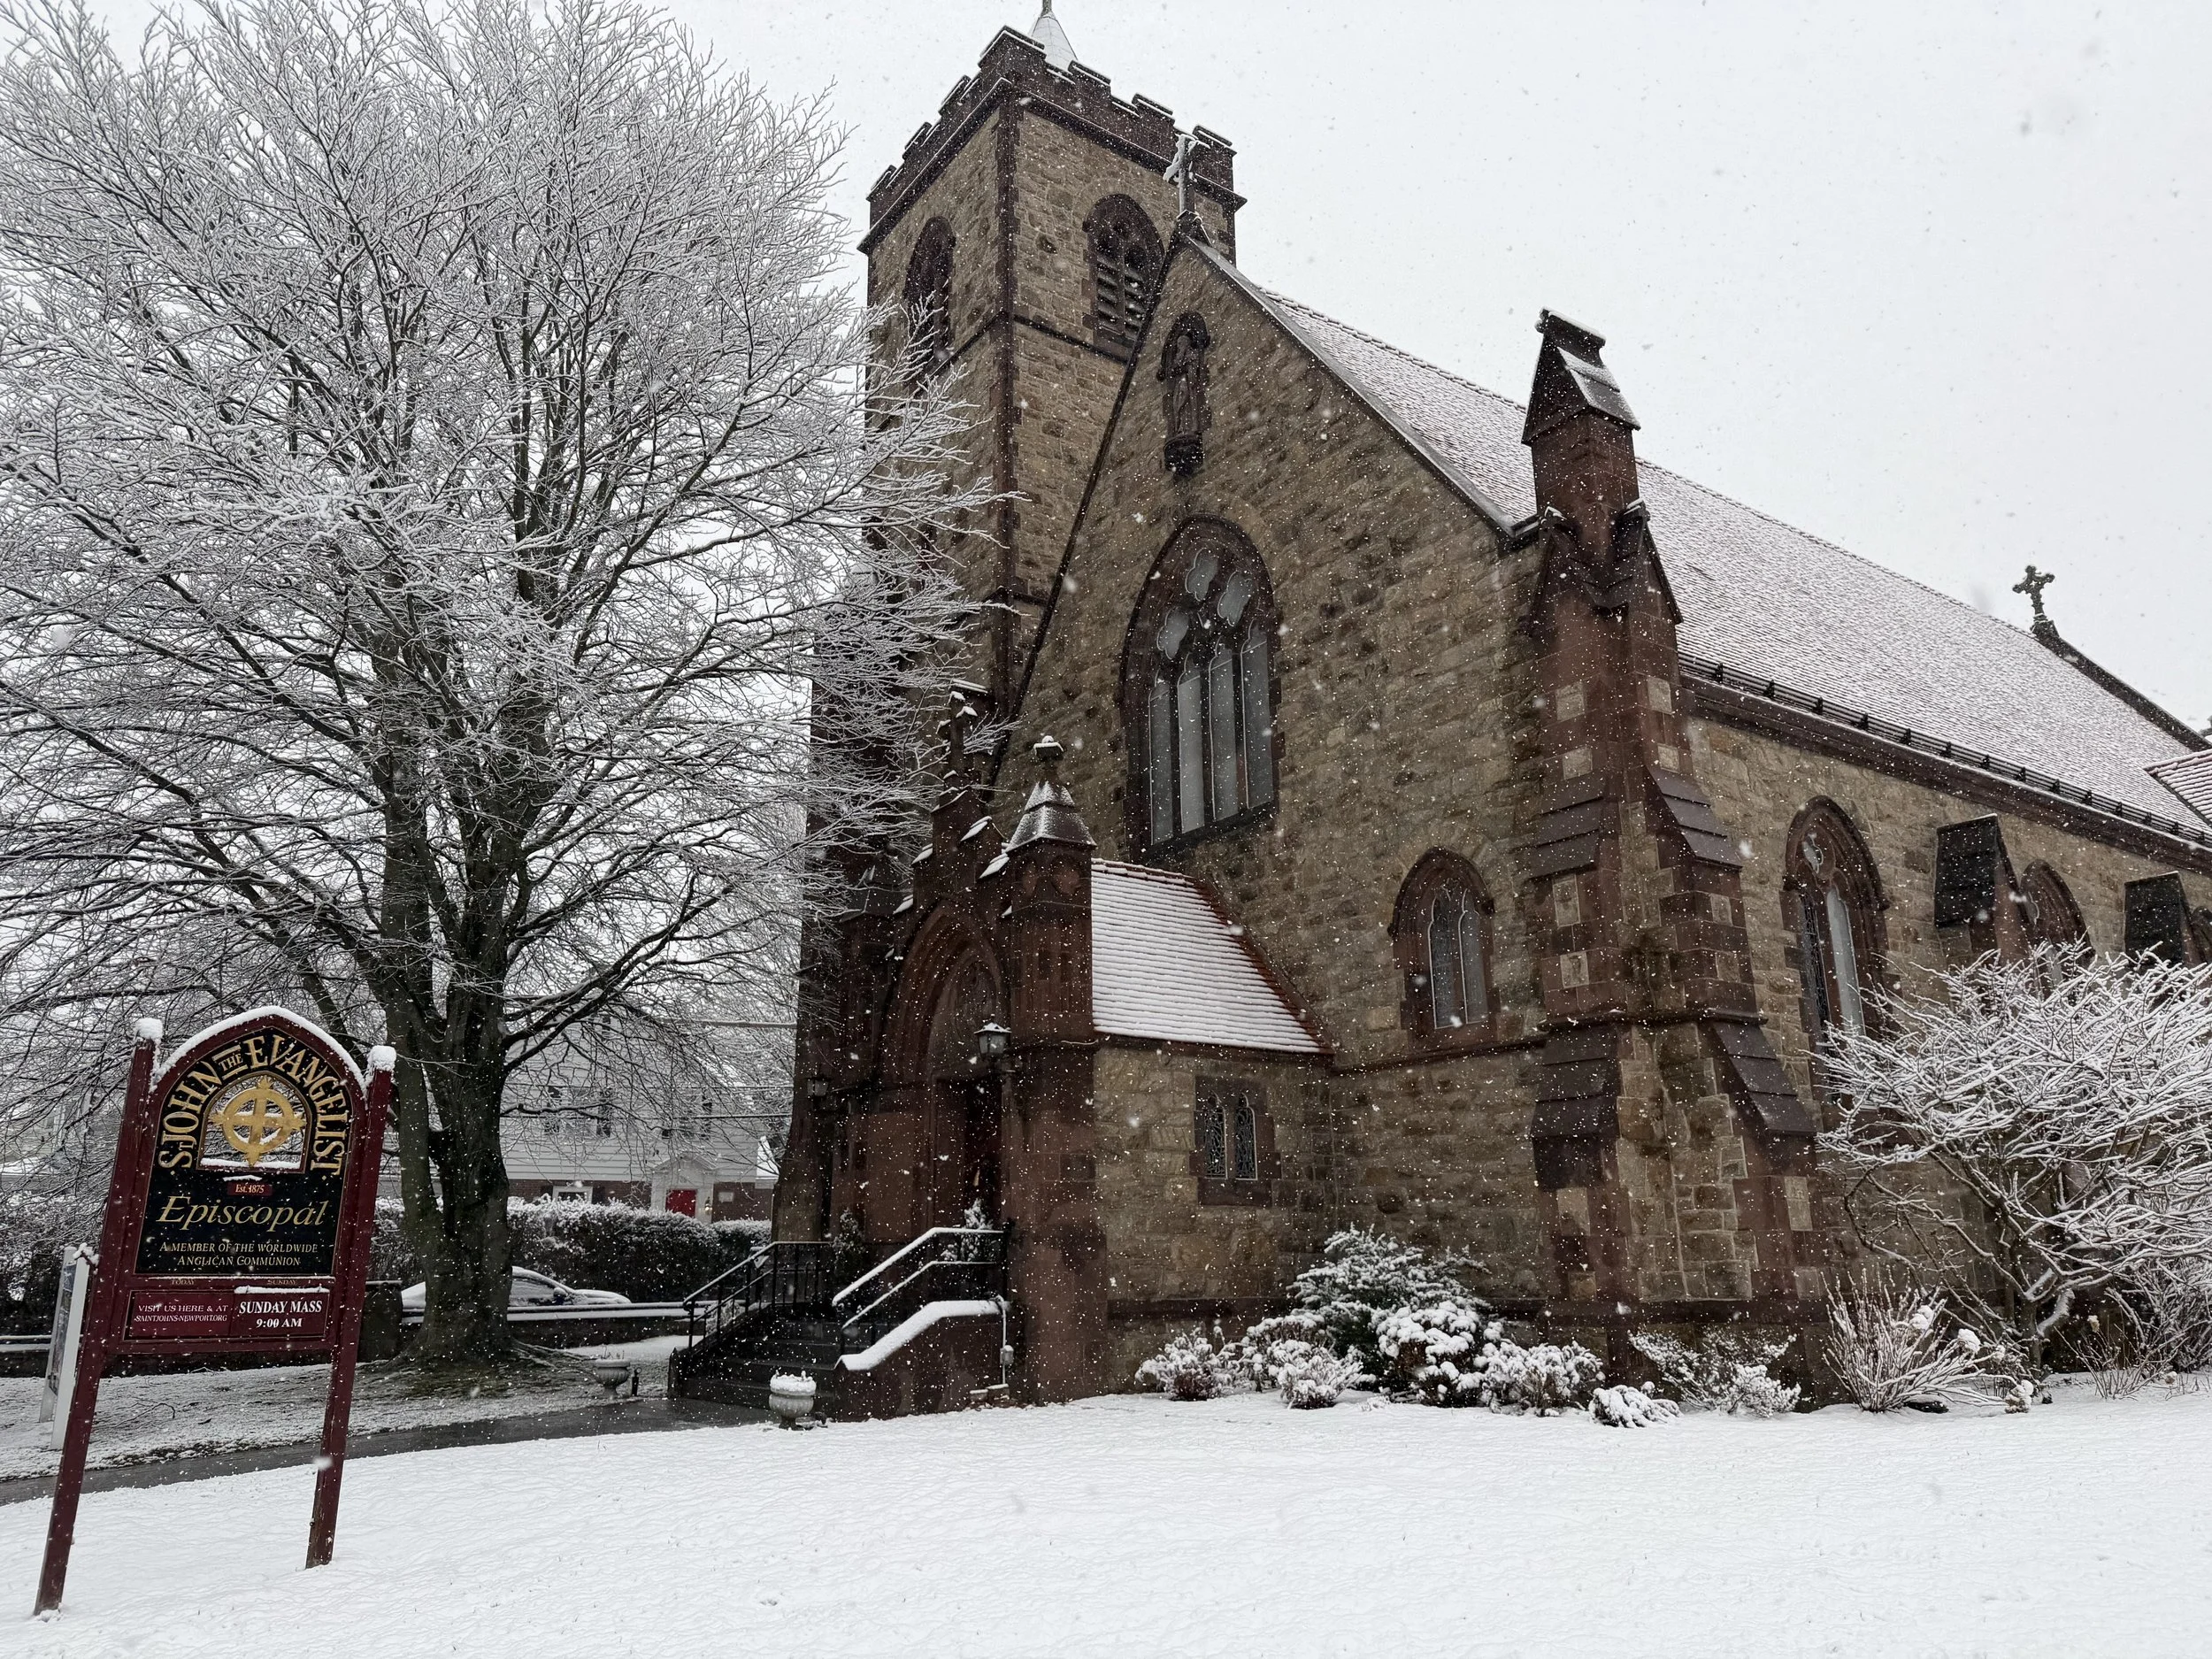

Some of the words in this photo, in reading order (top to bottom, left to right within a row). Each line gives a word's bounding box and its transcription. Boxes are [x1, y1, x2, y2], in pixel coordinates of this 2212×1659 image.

[161, 1061, 223, 1146] JOHN
[219, 1053, 243, 1071] THE
[244, 1034, 349, 1176] EVANGELIST
[249, 1184, 265, 1194] 1875
[156, 1195, 329, 1233] Episcopal
[159, 1241, 168, 1252] A
[171, 1242, 215, 1252] MEMBER
[219, 1242, 231, 1252] OF
[234, 1242, 254, 1252] THE
[257, 1243, 318, 1253] WORLDWIDE
[177, 1255, 234, 1266] ANGLICAN
[236, 1256, 300, 1266] COMMUNION
[239, 1301, 288, 1313] SUNDAY
[289, 1301, 323, 1313] MASS
[256, 1318, 280, 1327] 9:00
[281, 1317, 303, 1327] AM
